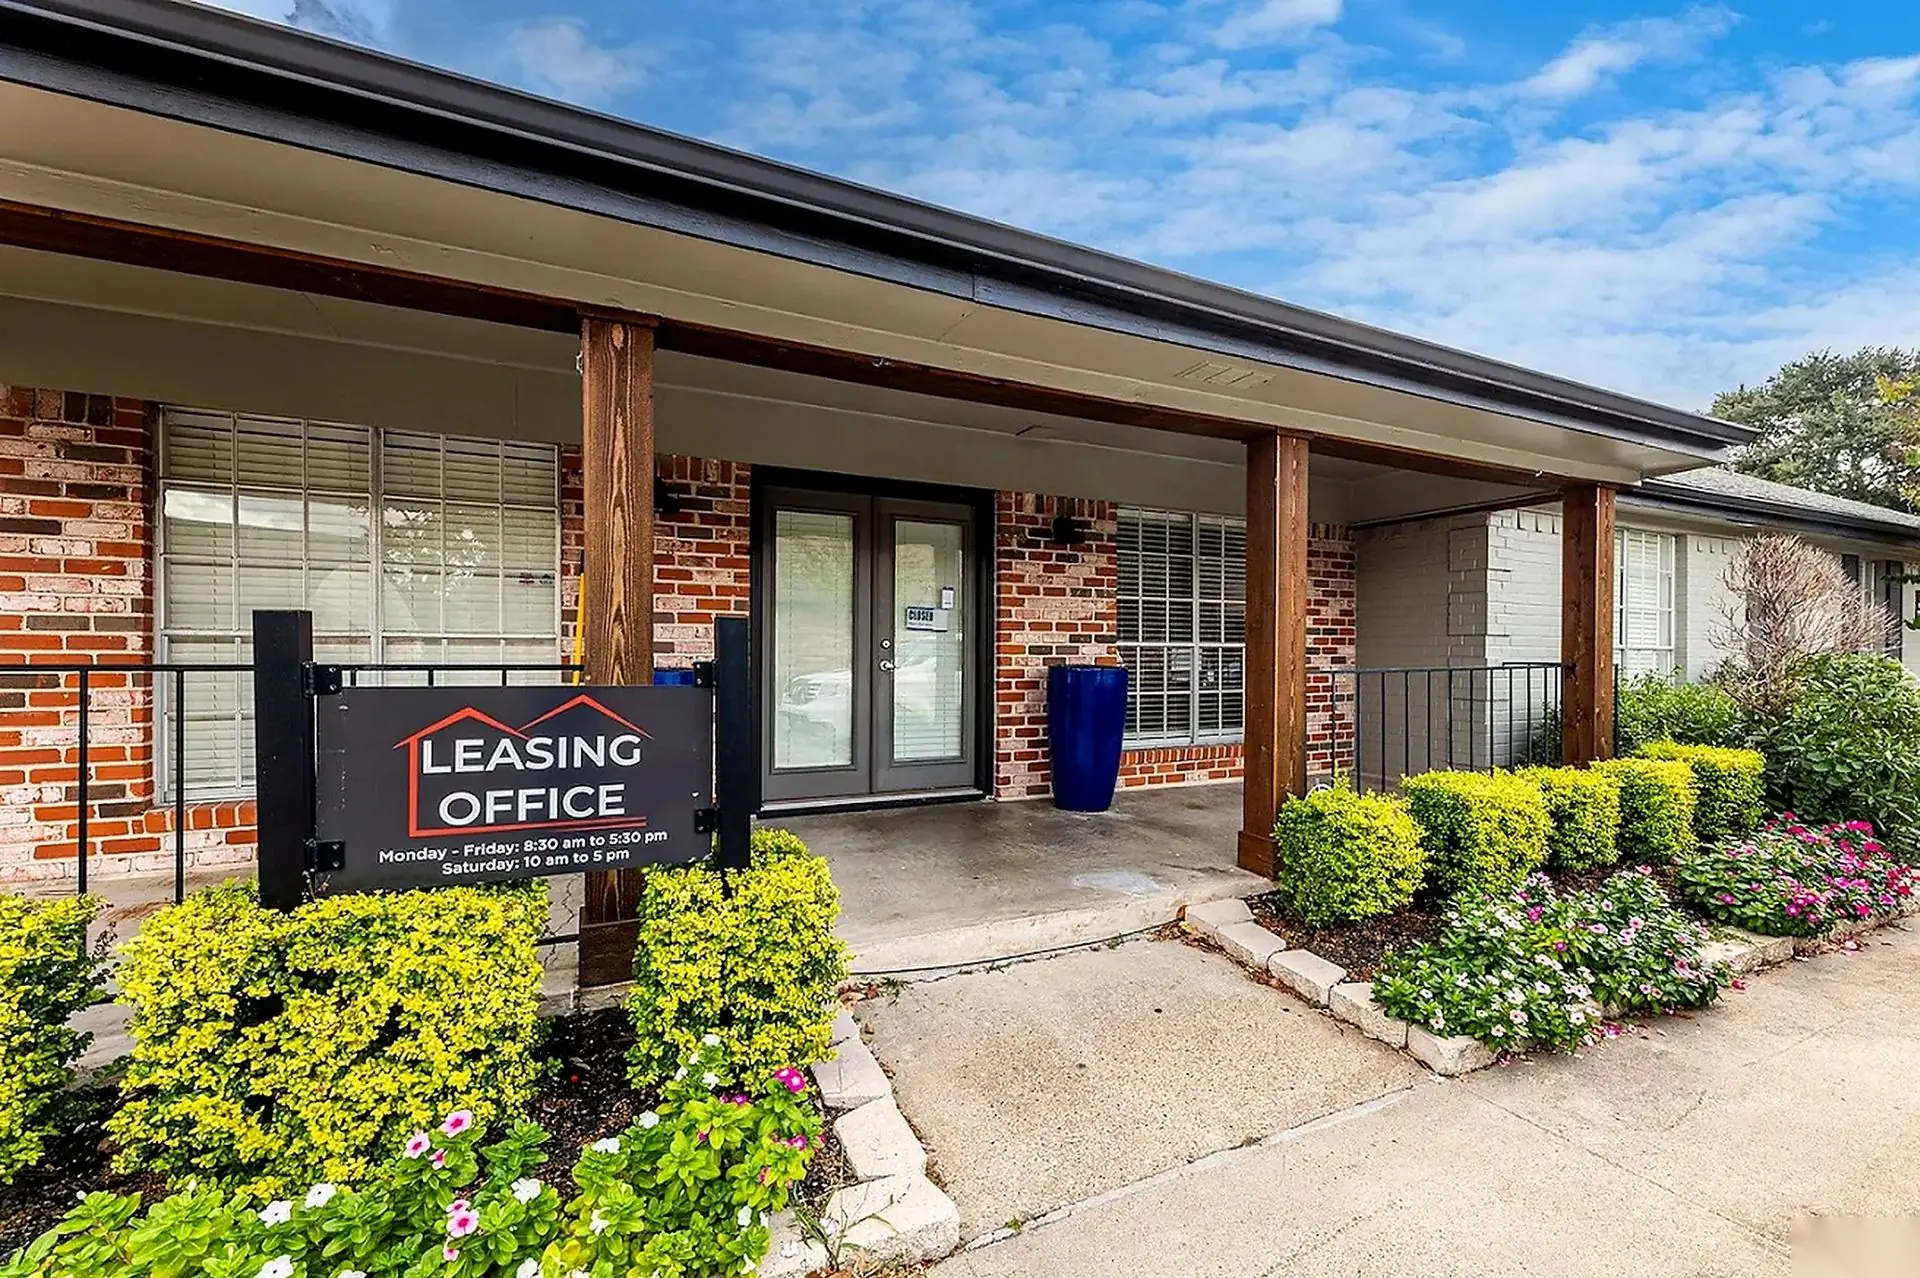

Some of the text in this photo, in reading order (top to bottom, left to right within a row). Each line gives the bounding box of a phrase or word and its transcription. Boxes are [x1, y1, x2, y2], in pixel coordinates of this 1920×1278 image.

[422, 734, 642, 774] LEASING
[438, 783, 626, 826] OFFICE
[379, 847, 448, 863] Monday
[463, 842, 520, 857] Friday:
[523, 838, 559, 852] 8:30
[562, 837, 586, 849] am
[589, 835, 606, 847] to
[609, 831, 642, 845] 5:30
[644, 830, 668, 844] pm
[441, 849, 630, 875] Saturday: 10 am to 5 pm
